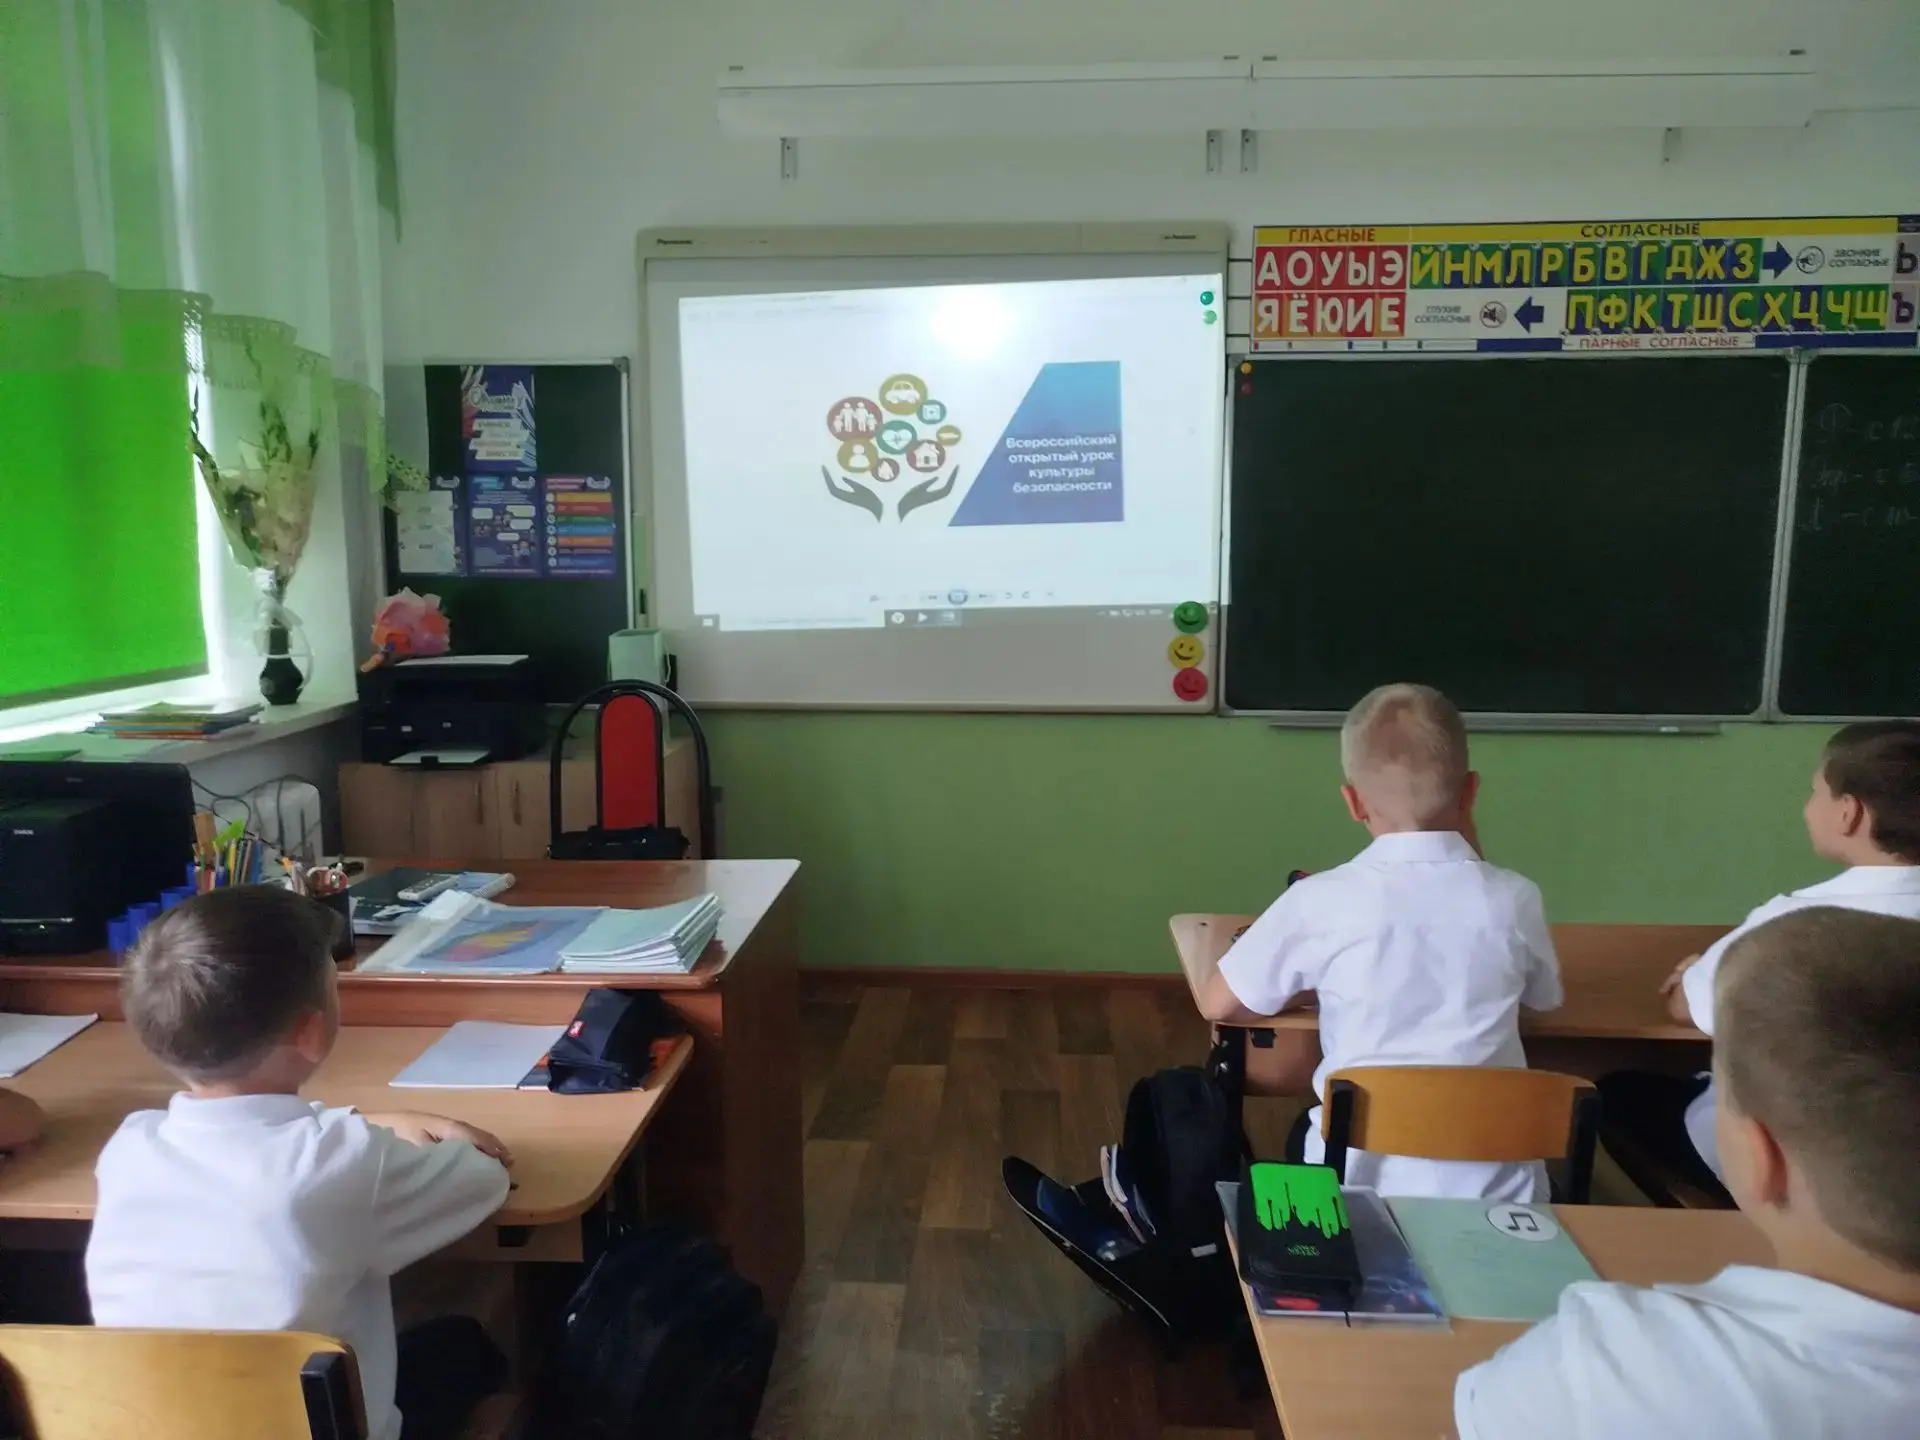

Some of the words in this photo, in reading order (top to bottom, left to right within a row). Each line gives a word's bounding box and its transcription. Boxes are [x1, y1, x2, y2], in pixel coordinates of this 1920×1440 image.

[1288, 228, 1376, 243] ГЛАСНЫЕ
[1581, 222, 1700, 238] СОГЛАСНЫЕ
[1579, 336, 1641, 349] ПАРНЫЕ
[1650, 335, 1739, 348] СОГЛАСНЫЕ
[1006, 434, 1116, 448] Всероссийский
[1008, 451, 1078, 464] открытый
[1081, 451, 1115, 463] урок
[1029, 467, 1095, 478] культуры
[1013, 481, 1112, 493] безопасности
